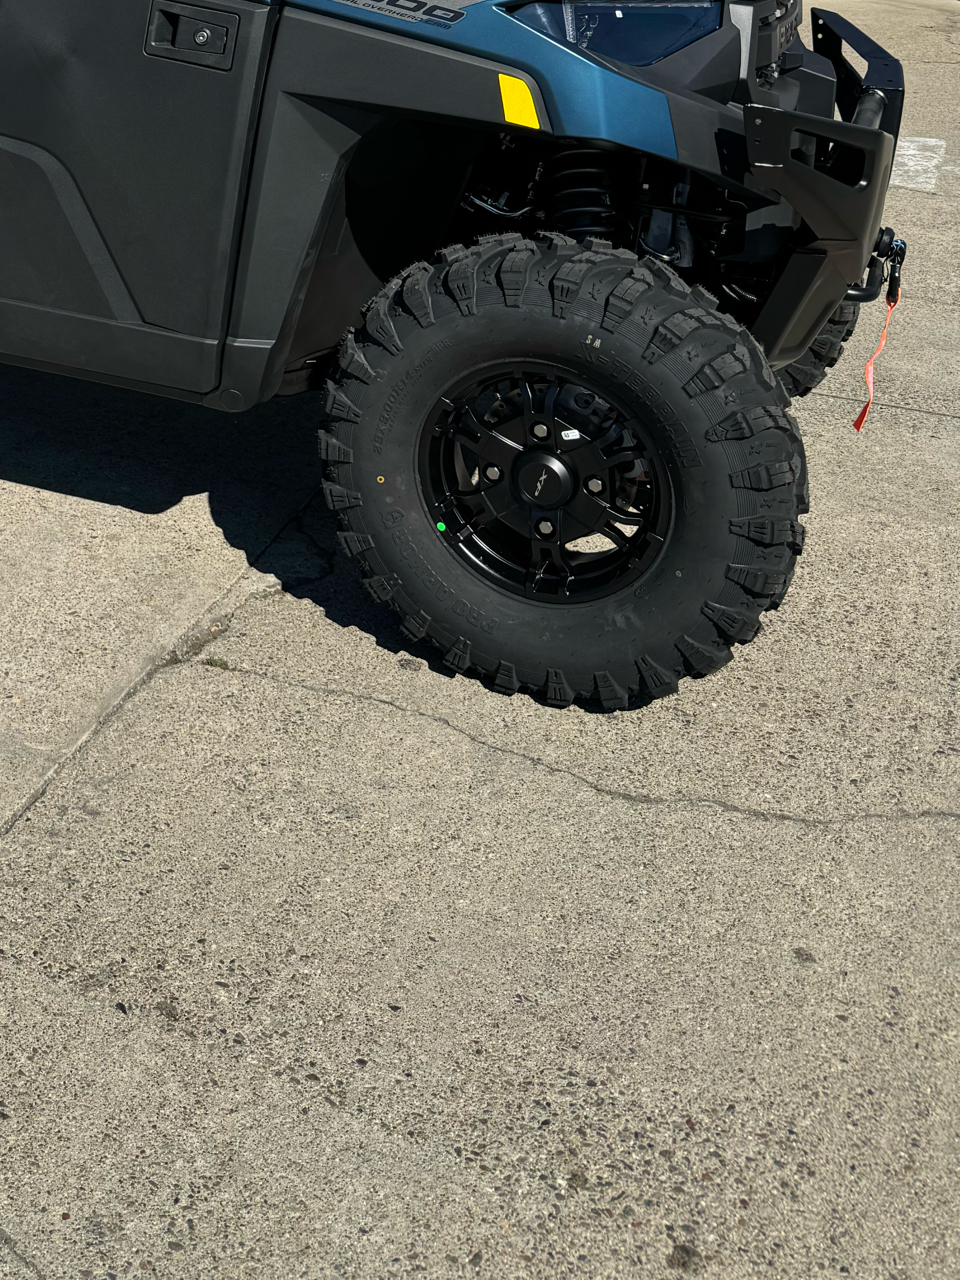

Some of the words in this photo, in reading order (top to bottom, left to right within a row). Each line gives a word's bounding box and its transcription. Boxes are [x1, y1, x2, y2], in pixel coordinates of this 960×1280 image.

[362, 0, 423, 22] OVERHEAD
[424, 17, 452, 30] CAM
[573, 340, 704, 469] X-TERRAIN
[534, 468, 548, 497] XP
